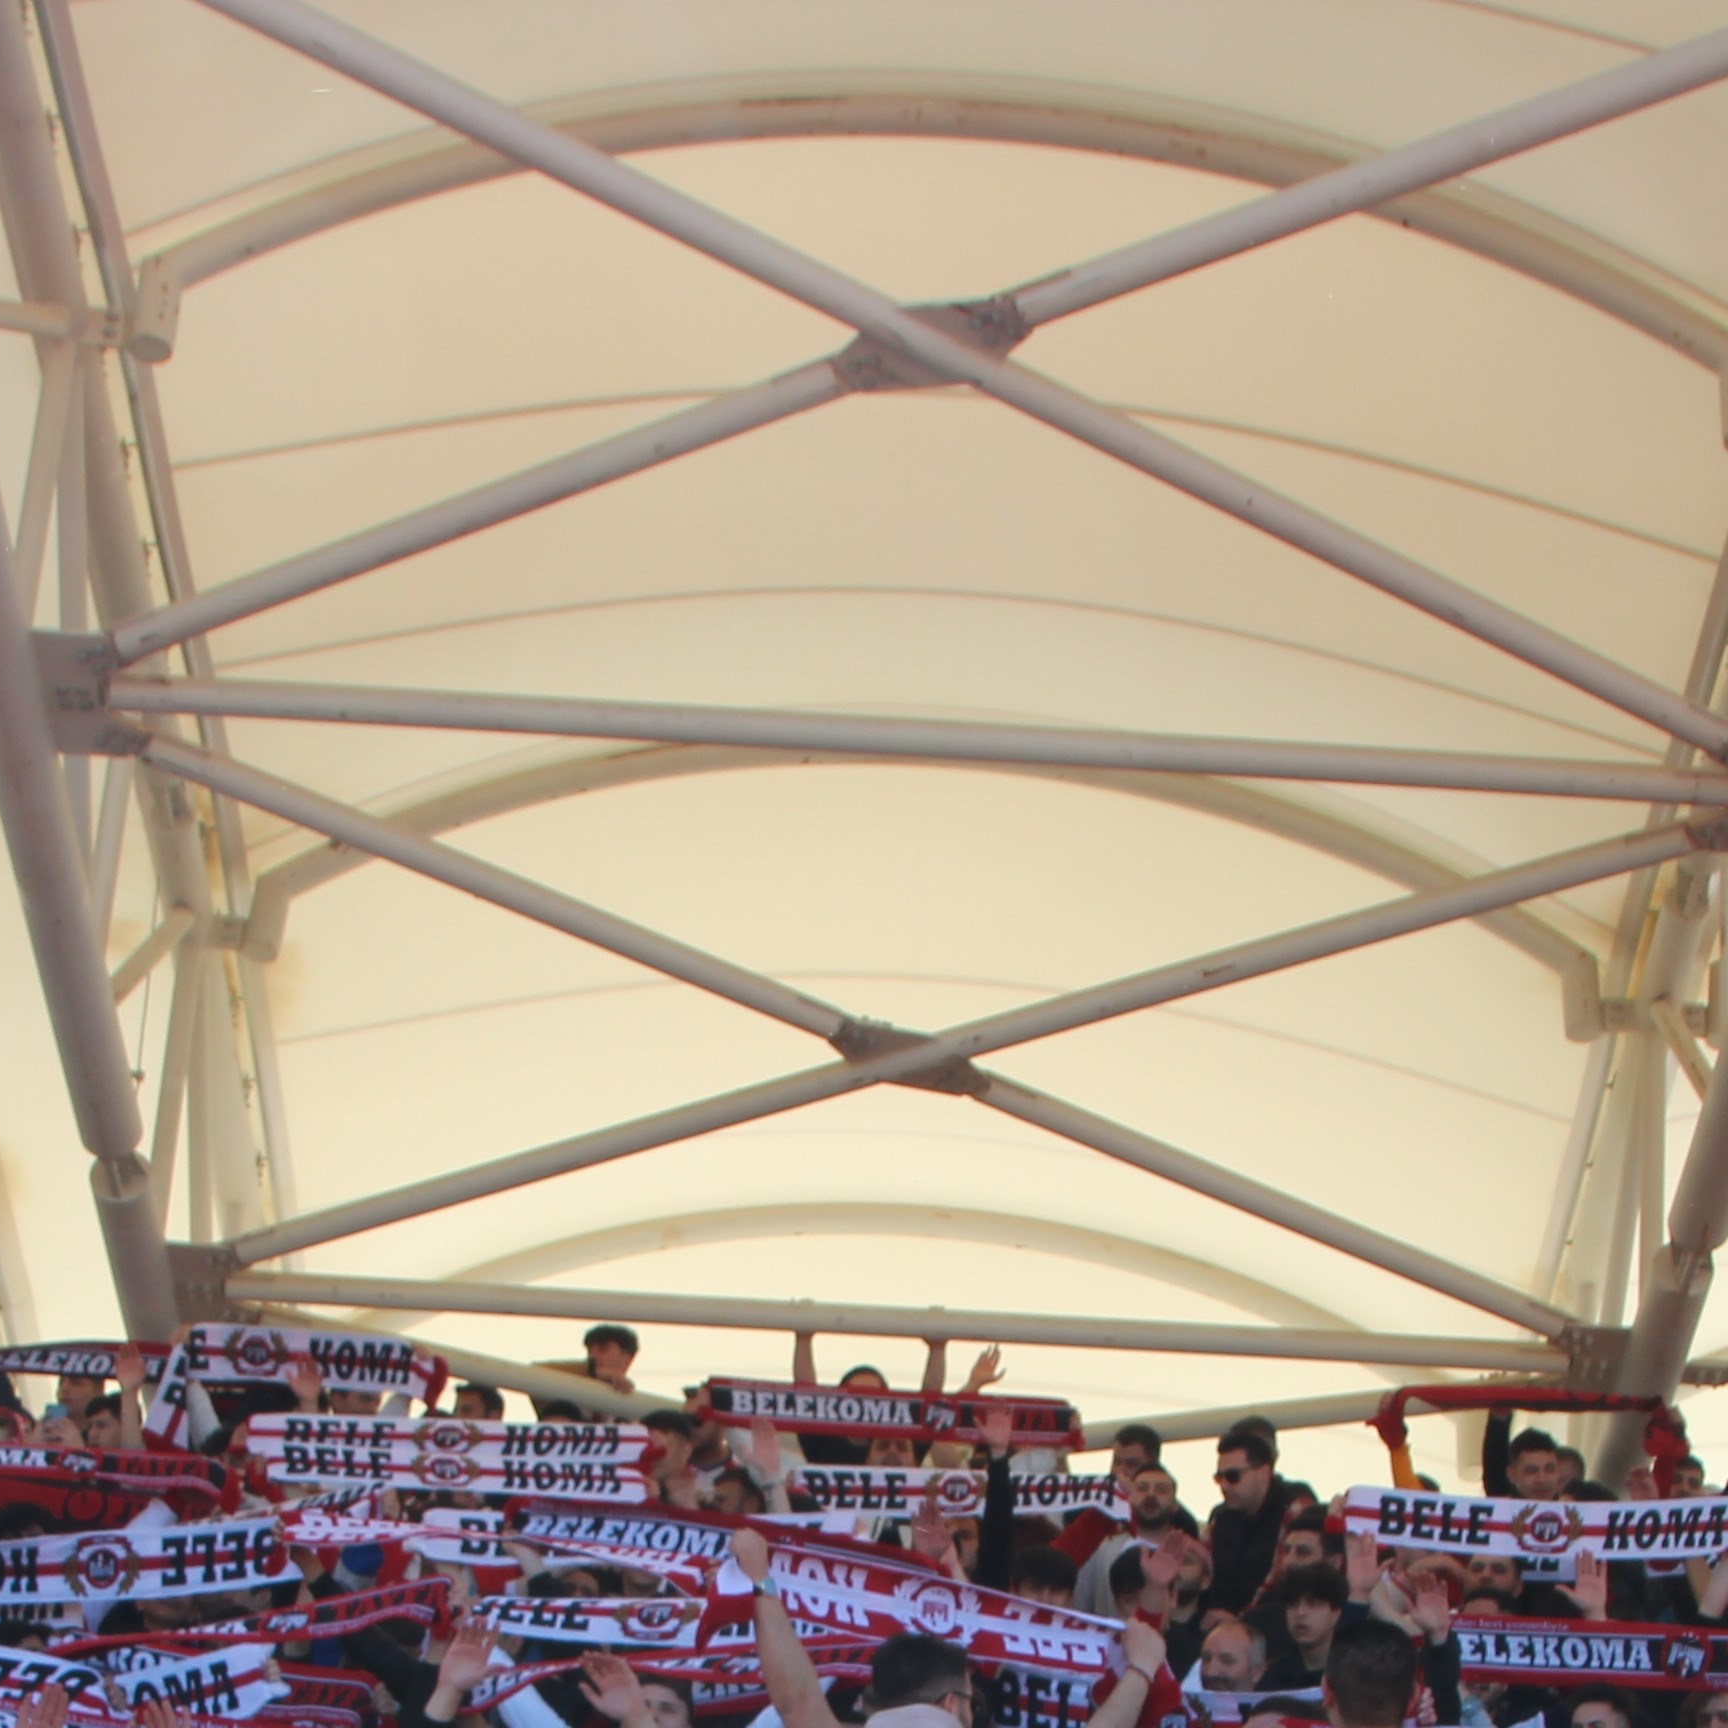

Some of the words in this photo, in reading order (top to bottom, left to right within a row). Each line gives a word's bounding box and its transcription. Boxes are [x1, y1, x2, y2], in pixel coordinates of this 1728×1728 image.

[732, 1389, 914, 1426] BELEKOMA
[502, 1425, 620, 1459] KOMA
[283, 1445, 394, 1482] BELE
[502, 1460, 622, 1494] KOMA
[803, 1468, 908, 1509] BELE
[1378, 1494, 1494, 1546] BELE
[1603, 1504, 1727, 1550] KOMA
[1460, 1633, 1653, 1671] ELEKOMA
[133, 1659, 239, 1711] OMA
